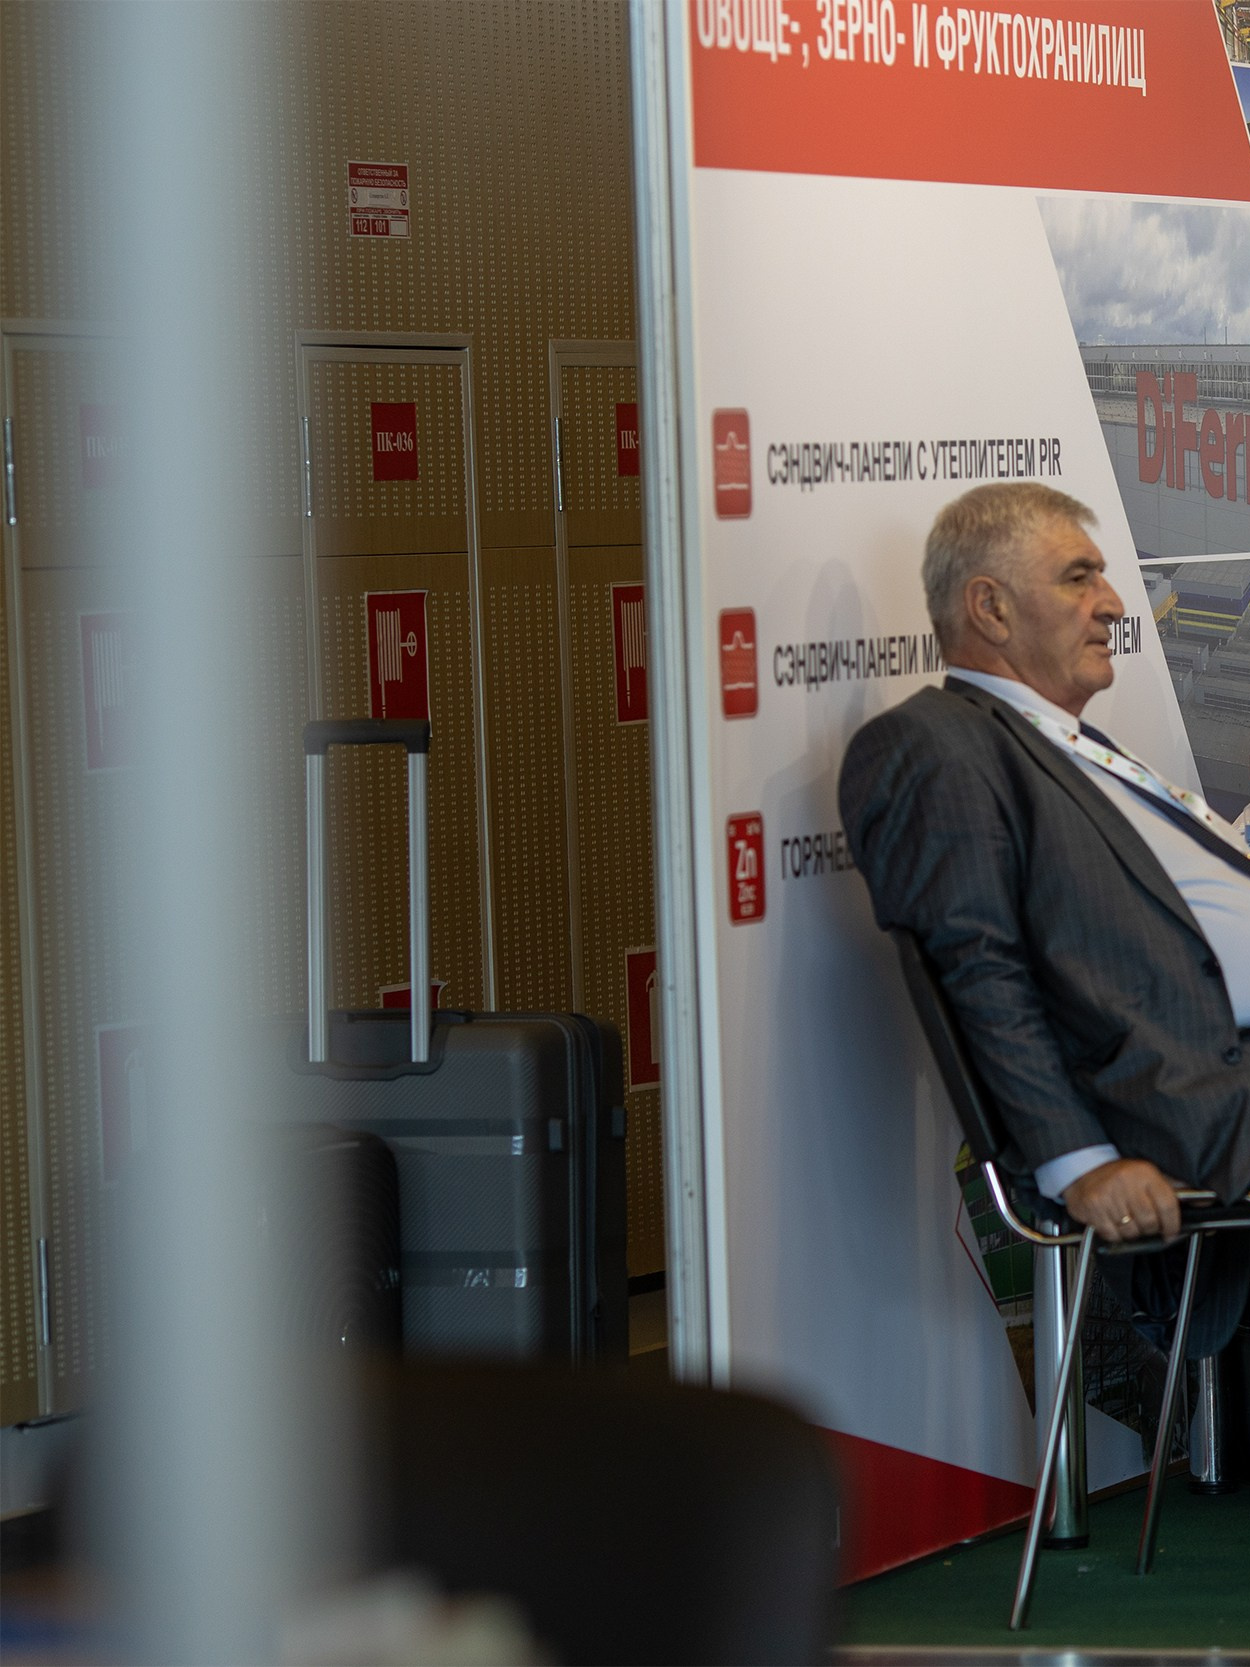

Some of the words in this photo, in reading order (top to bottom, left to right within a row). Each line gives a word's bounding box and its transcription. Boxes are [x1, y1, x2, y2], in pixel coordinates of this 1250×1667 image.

[816, 0, 905, 66] ЗЕРНО-
[912, 3, 929, 68] И
[935, 6, 1147, 97] ФРУКТОХРАНИЛИЩ
[374, 178, 406, 187] БЕЗОПАСНОСТЬ
[356, 219, 368, 232] 112
[374, 220, 386, 233] 101
[86, 436, 129, 458] ПК-0
[376, 431, 413, 452] ПК-036
[621, 430, 641, 449] ПК-
[767, 441, 913, 492] СЭНДВИЧ-ПАНЕЛИ
[917, 440, 927, 480] С
[931, 438, 1035, 480] УТЕПЛИТЕЛЕМ
[1039, 437, 1062, 476] PIR
[773, 634, 918, 692] СЭНДВИЧ-ПАНЕЛИ
[922, 633, 948, 674] МИ
